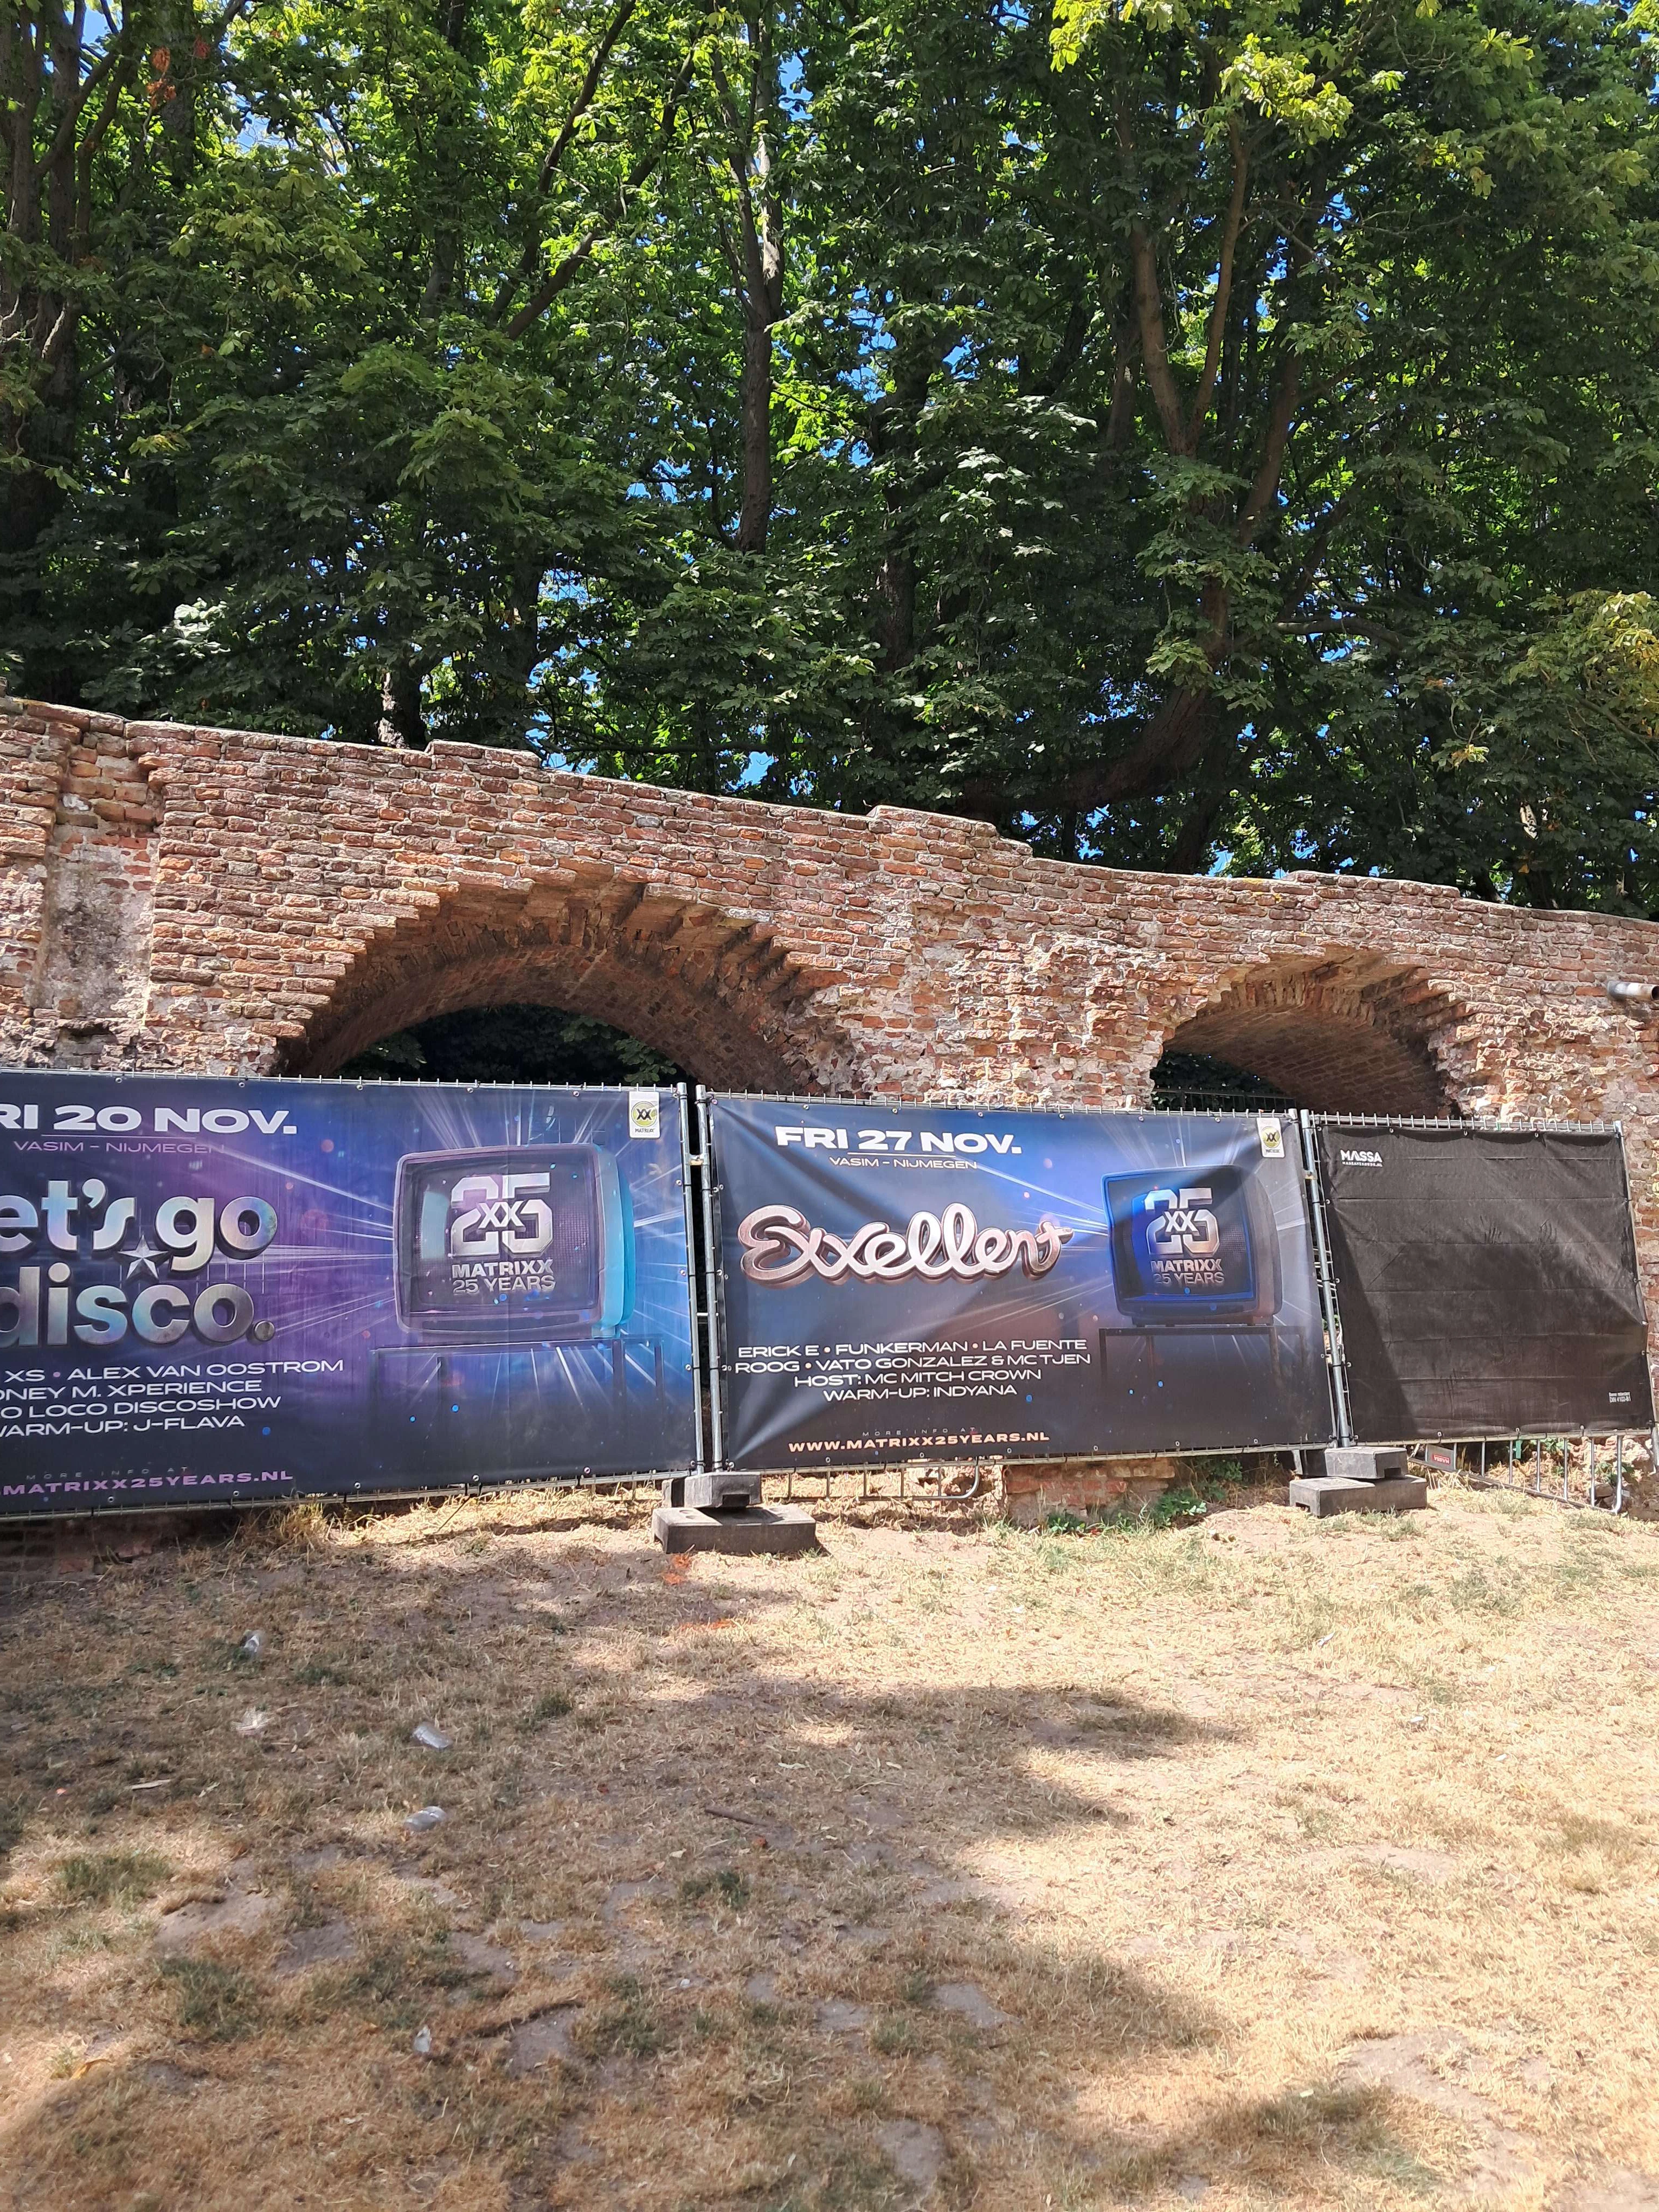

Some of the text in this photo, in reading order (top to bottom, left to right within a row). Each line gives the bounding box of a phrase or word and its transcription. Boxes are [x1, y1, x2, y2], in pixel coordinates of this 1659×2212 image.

[54, 1105, 142, 1131] 20
[154, 1108, 297, 1134] NOV.
[14, 1140, 83, 1152] VASIM
[106, 1142, 224, 1154] NIJMEGEN
[775, 1126, 1022, 1154] FRI 27 NOV.
[828, 1156, 879, 1167] VASIM
[893, 1159, 978, 1169] NIJMEGEN
[1340, 1149, 1382, 1163] MASSA
[155, 1195, 278, 1272] go
[452, 1259, 554, 1278] MATRIXX
[1150, 1258, 1223, 1272] MATRIXX
[453, 1275, 556, 1294] 25 YEARS
[1153, 1271, 1225, 1285] 25 YEARS
[738, 1339, 1088, 1358] ERICK E FUNKERMAN LA FUENTE
[4, 1359, 344, 1382] XS ALEX VAN OOSTROM
[735, 1353, 1091, 1374] ROOG VATO GONZALEZ & MC TJEN
[794, 1368, 1041, 1387] HOST: MC MITCH CROWN
[0, 1379, 262, 1401] NEY M. XPERIENCE
[823, 1384, 1017, 1402] WARM-UP: INDYANA
[28, 1403, 108, 1418] LOCO
[113, 1396, 281, 1415] DISCOSHOW
[133, 1415, 245, 1432] J-FLAVA
[788, 1432, 1050, 1452] WWW.MATRIXX25YEARS.NL
[26, 1471, 82, 1480] MORE
[101, 1468, 150, 1476] INFO
